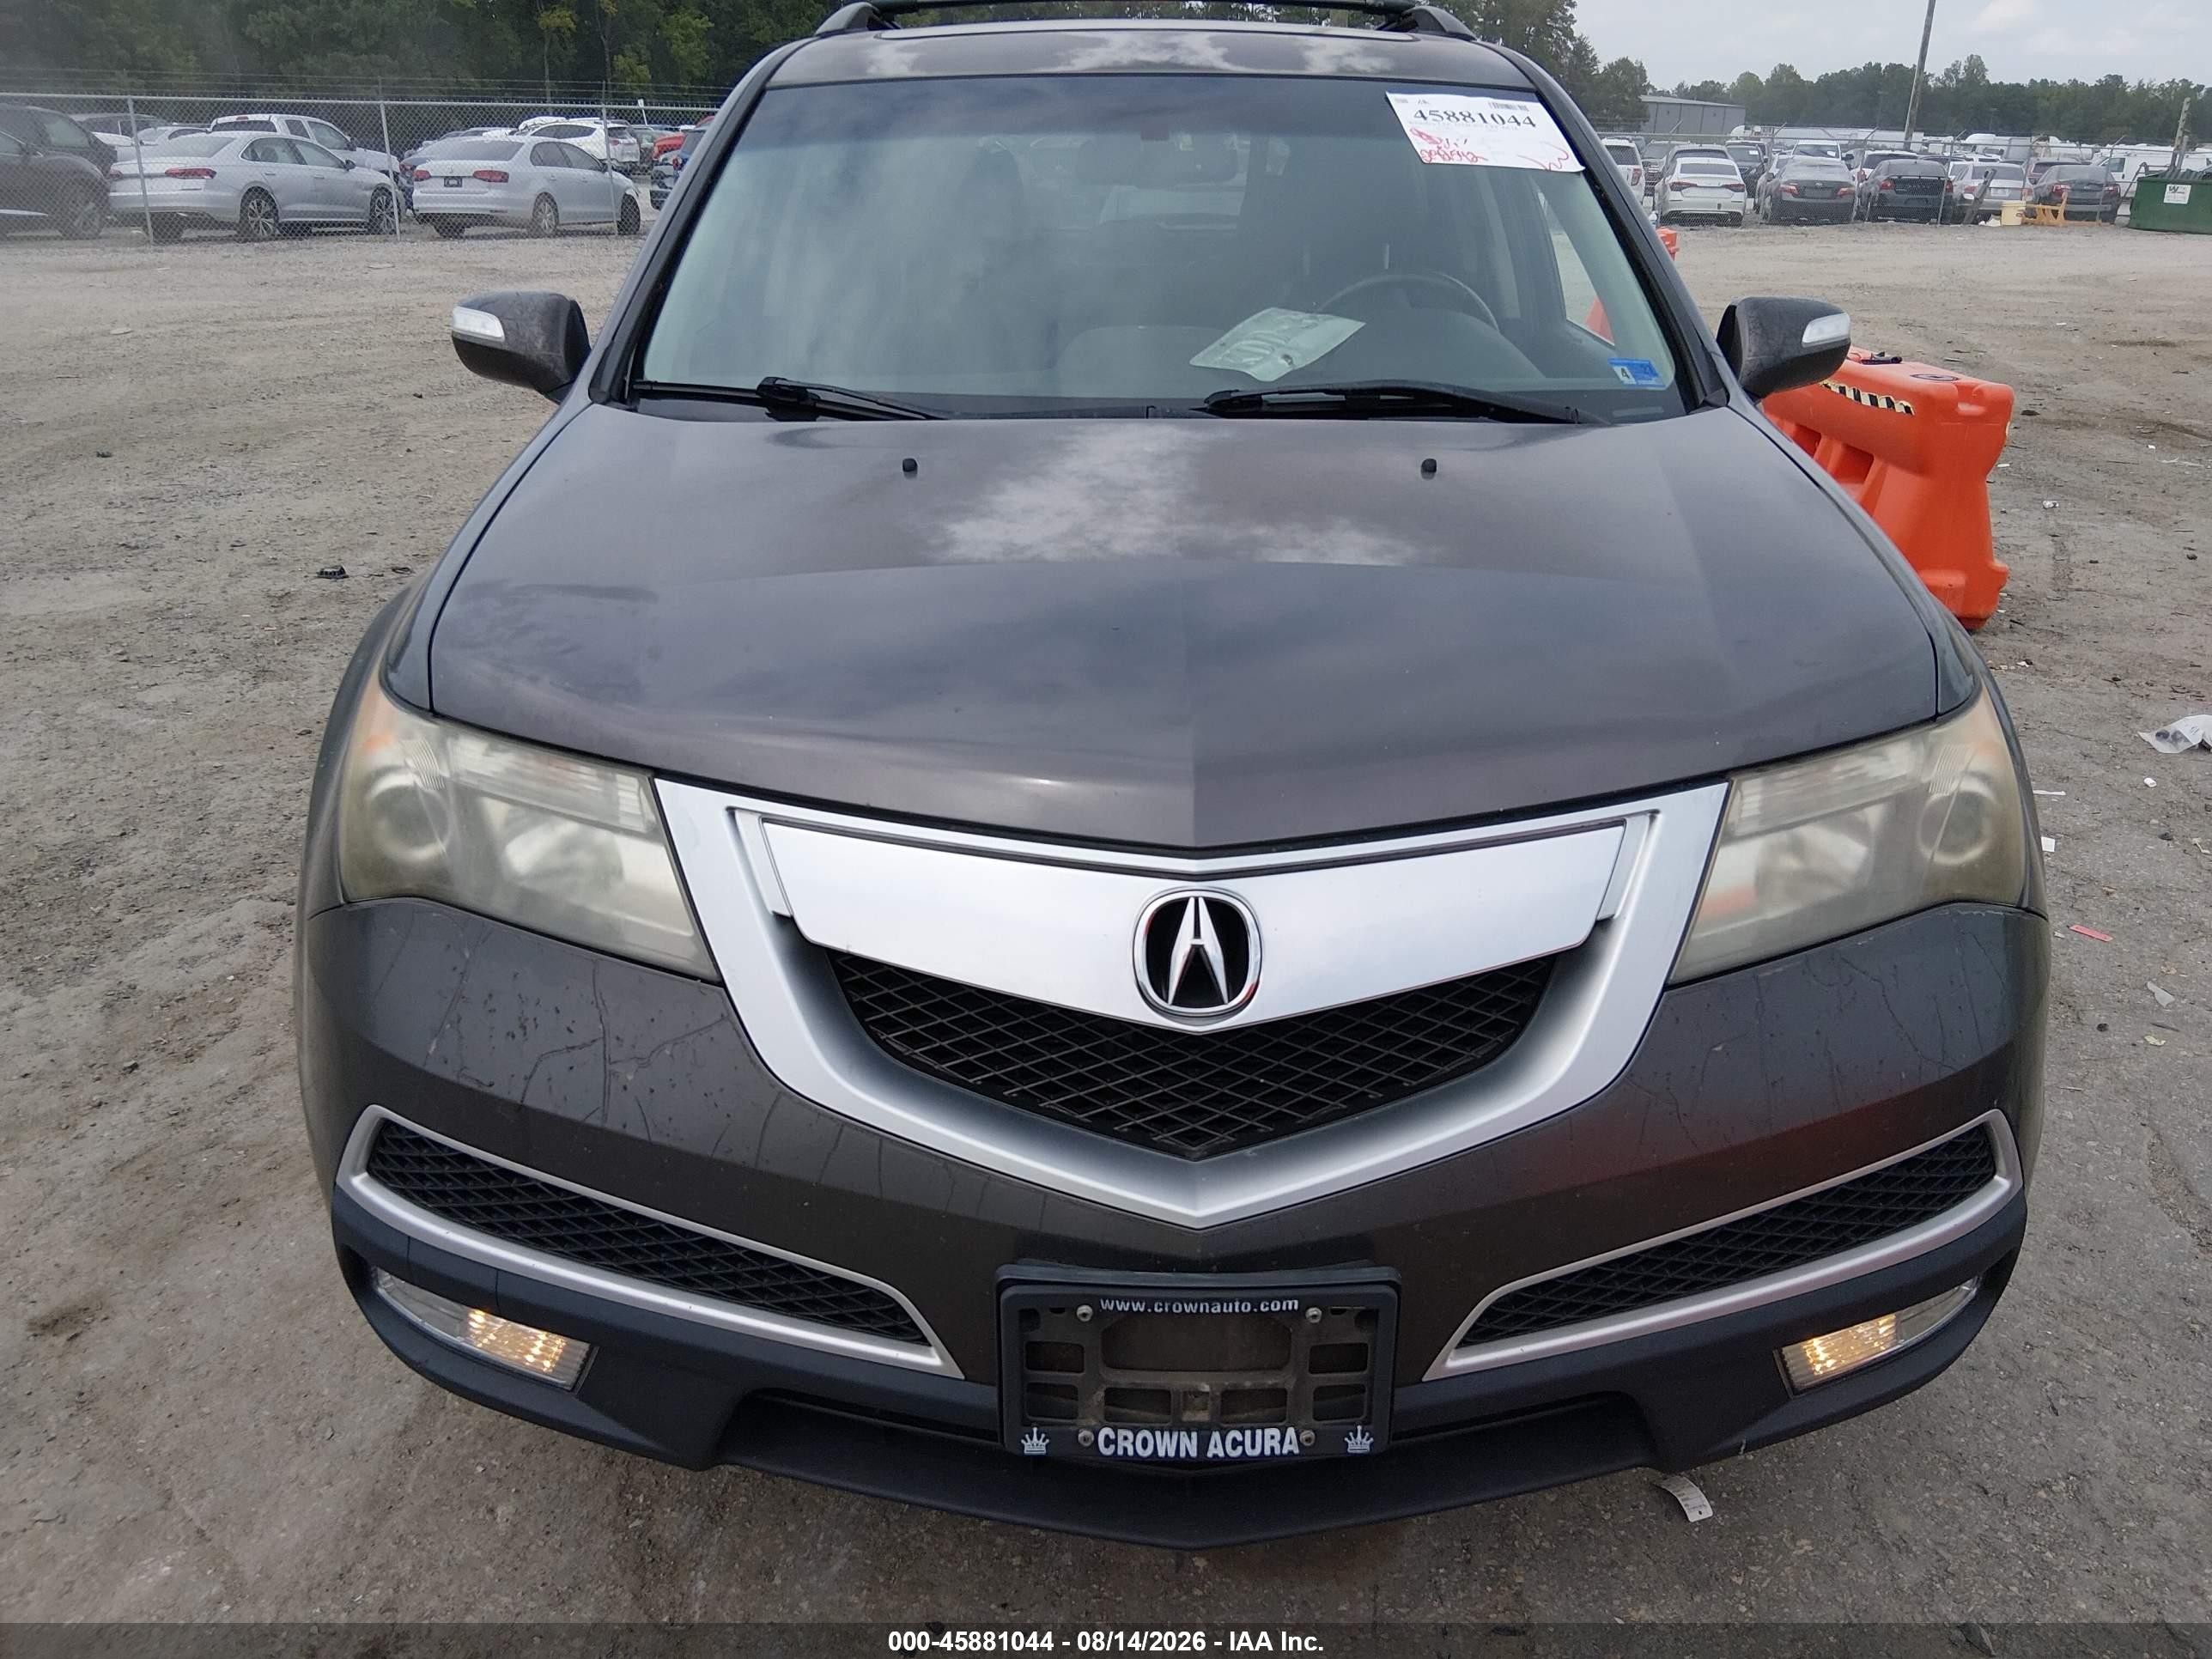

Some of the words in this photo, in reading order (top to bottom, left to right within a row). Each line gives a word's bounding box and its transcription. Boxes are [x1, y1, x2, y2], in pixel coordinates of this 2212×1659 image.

[1413, 109, 1536, 128] 45881044
[1101, 1297, 1299, 1314] www.crownauto.com
[1097, 1426, 1198, 1458] CROWN
[1206, 1426, 1300, 1458] ACURA
